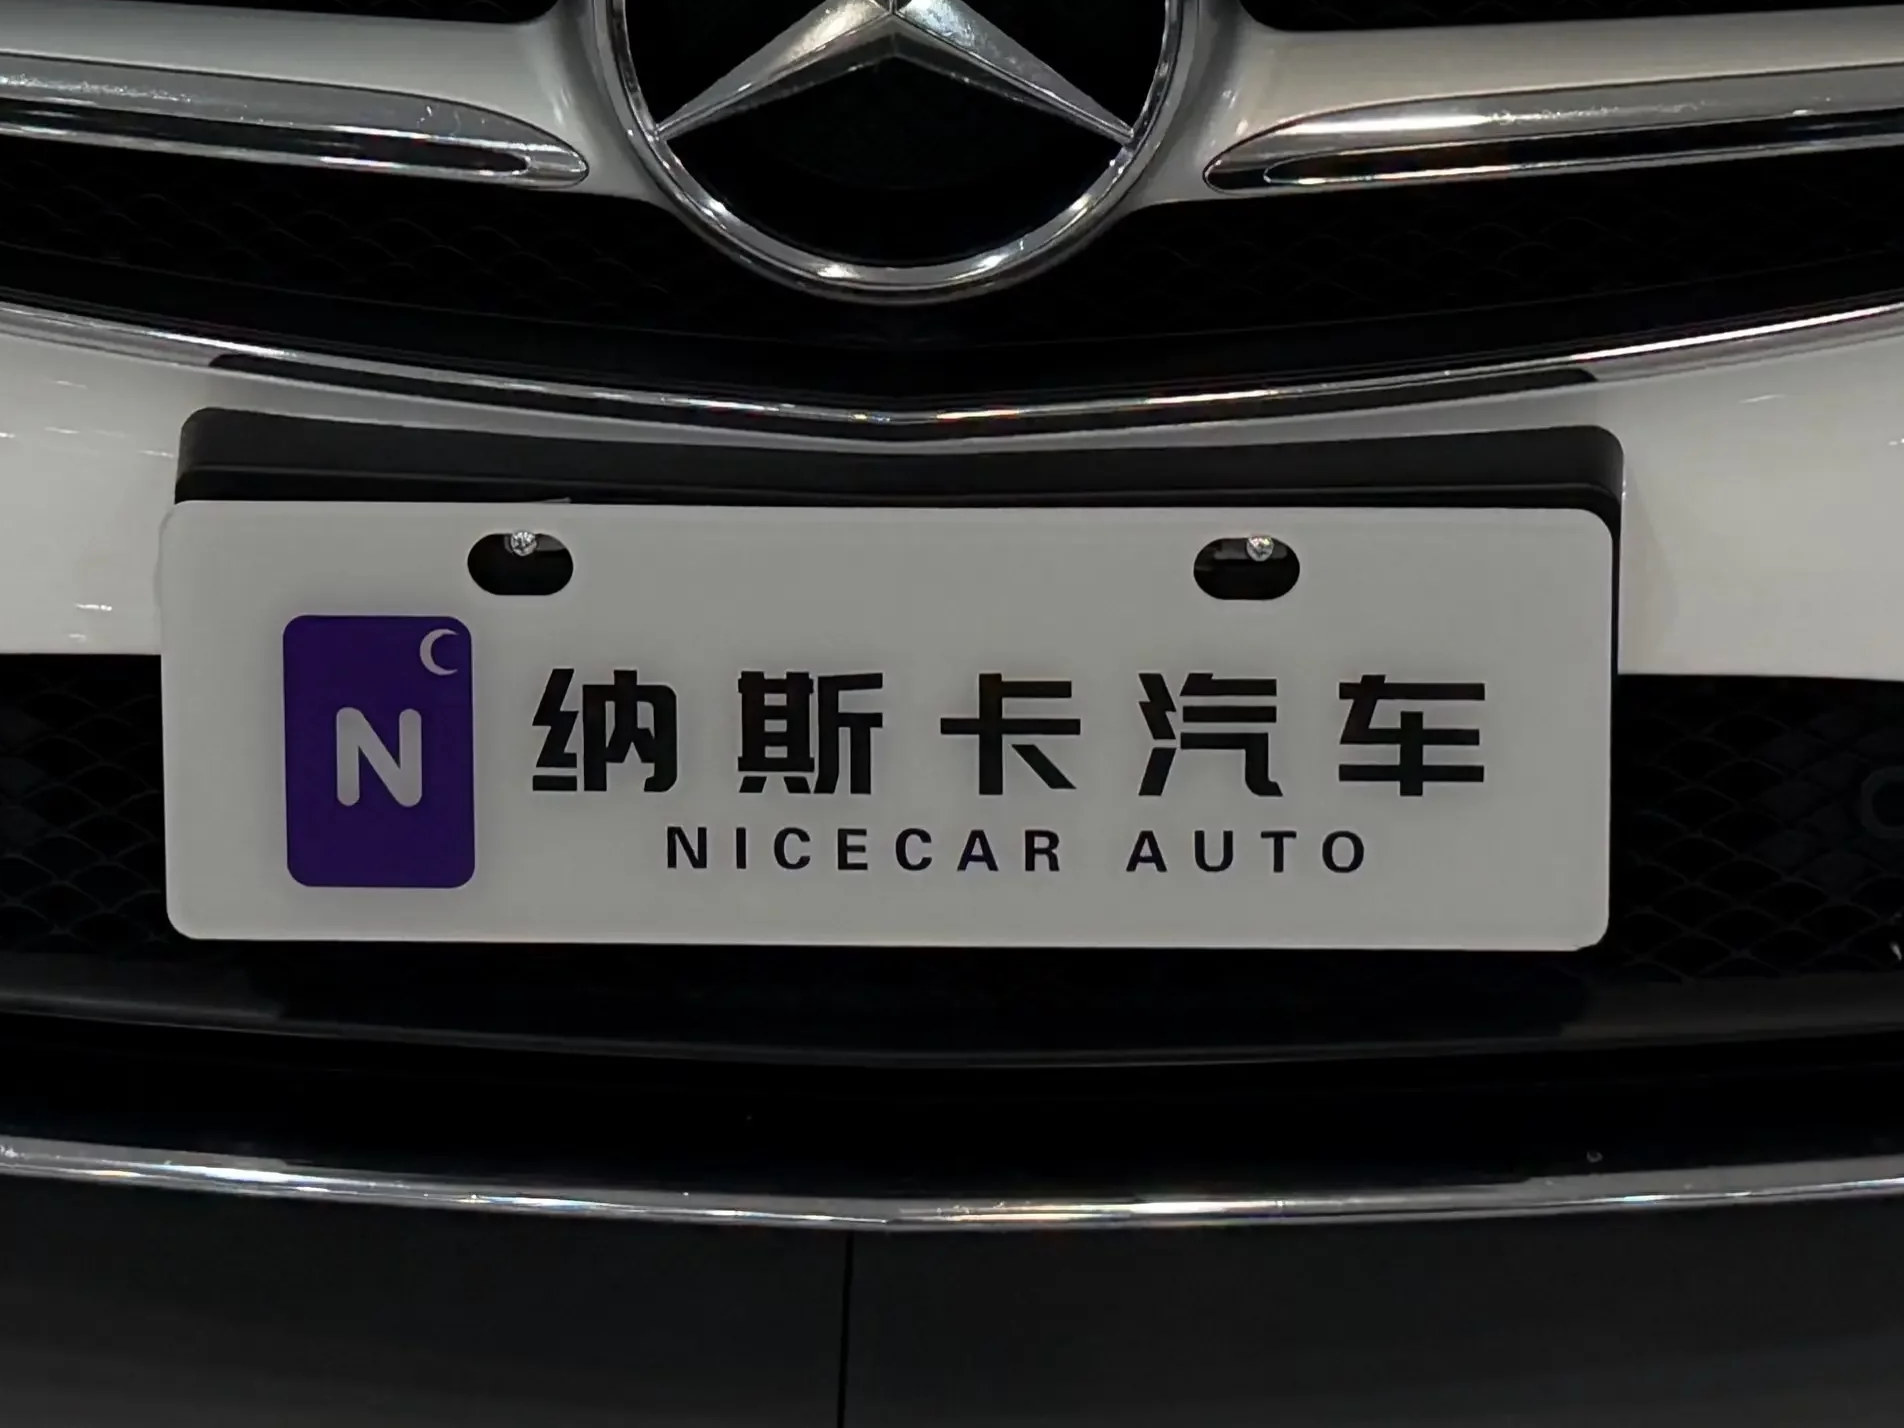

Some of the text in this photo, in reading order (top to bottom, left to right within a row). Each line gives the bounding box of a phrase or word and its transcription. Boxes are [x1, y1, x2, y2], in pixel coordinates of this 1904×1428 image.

[335, 705, 424, 808] N
[530, 667, 1488, 800] 纳斯卡汽车
[664, 825, 1368, 876] NICECAR AUTO
